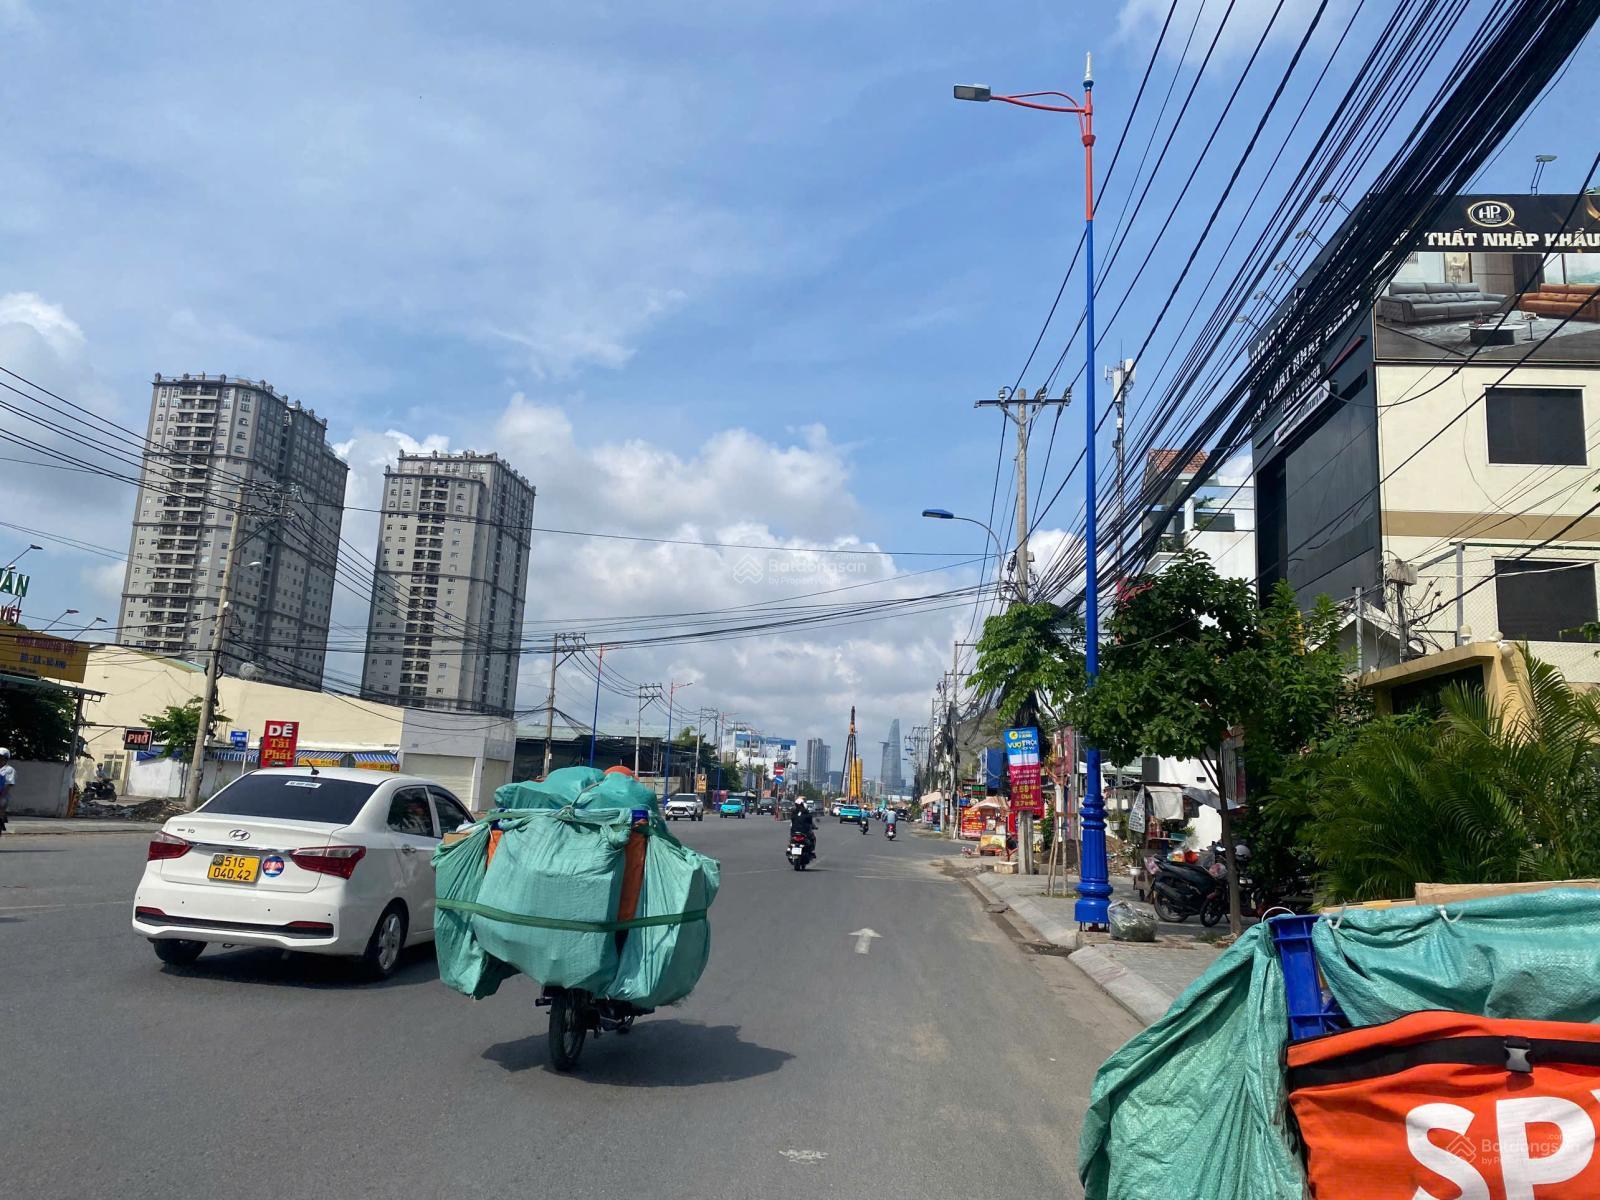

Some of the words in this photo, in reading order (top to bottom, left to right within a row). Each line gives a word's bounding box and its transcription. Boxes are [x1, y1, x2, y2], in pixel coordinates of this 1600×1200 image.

[1479, 205, 1501, 219] HP
[1424, 227, 1478, 246] THẤT
[1482, 230, 1540, 249] NHẬP
[268, 723, 294, 738] DÊ
[224, 856, 246, 868] 51G
[213, 867, 251, 881] 040.42
[1406, 1089, 1600, 1200] SP
